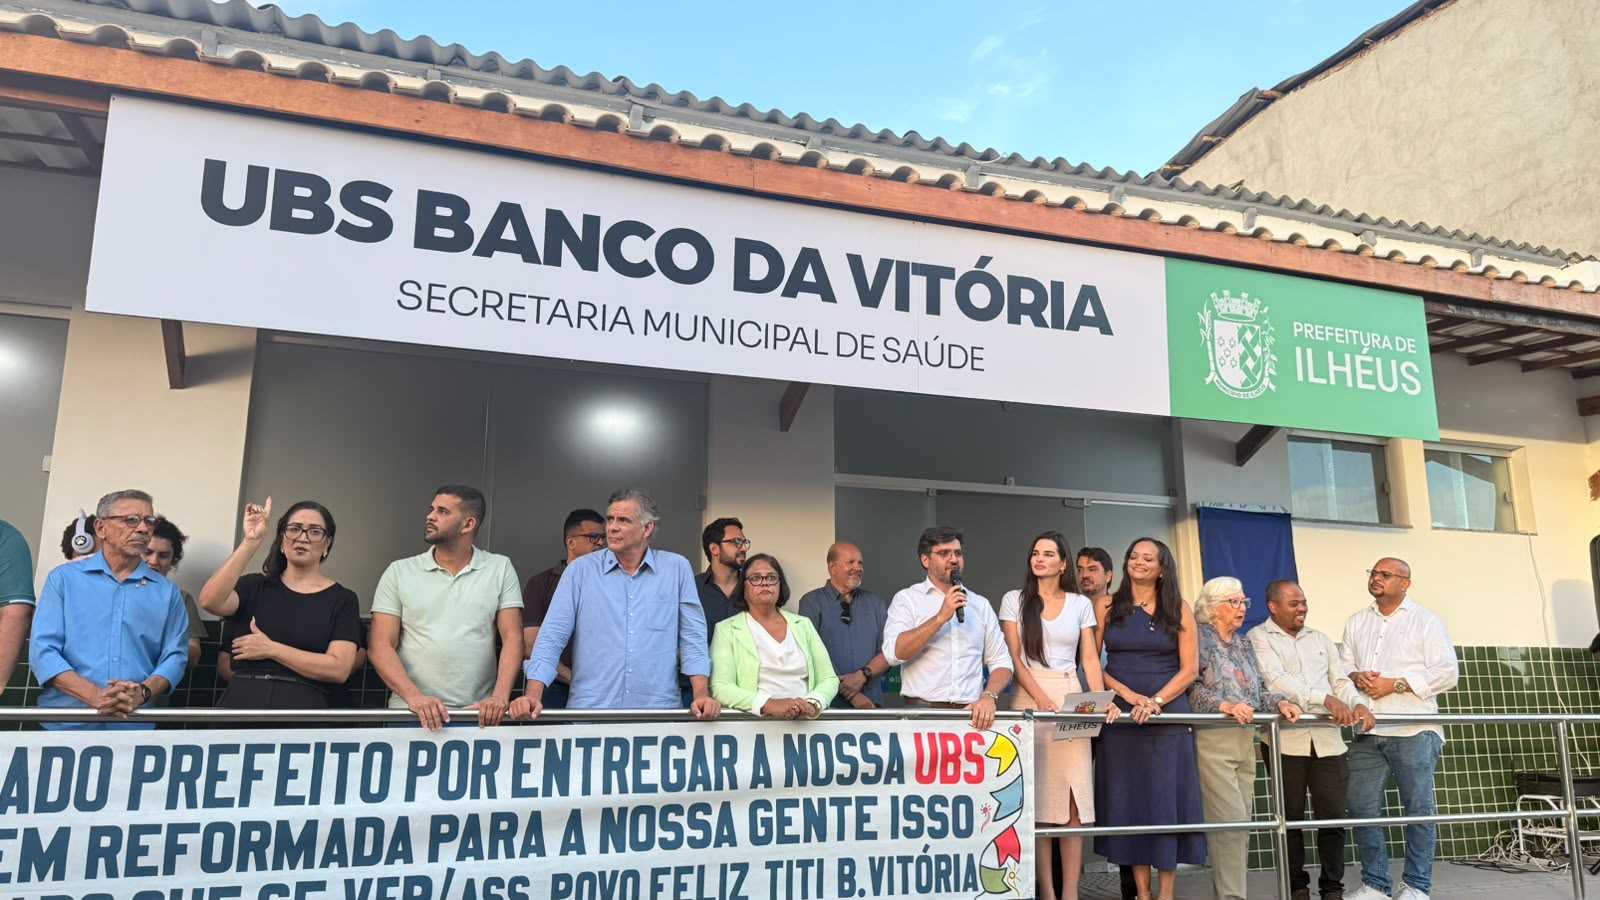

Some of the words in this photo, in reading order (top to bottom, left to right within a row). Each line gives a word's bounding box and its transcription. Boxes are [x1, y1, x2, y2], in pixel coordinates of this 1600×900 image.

[200, 158, 393, 244] UBS
[413, 188, 715, 286] BANCO
[732, 237, 838, 304] DA
[845, 252, 1114, 336] VITÓRIA
[396, 279, 635, 335] SECRETARIA
[643, 308, 829, 356] MUNICIPAL
[836, 331, 876, 361] DE
[882, 335, 985, 372] SAÚDE
[1293, 320, 1393, 351] PREFEITURA
[1394, 335, 1417, 354] DE
[1295, 346, 1422, 396] ILHÉUS
[127, 742, 393, 811] PREFEITO
[404, 740, 501, 802] POR
[511, 734, 739, 798] ENTREGAR
[749, 734, 773, 790] A
[783, 732, 906, 789] NOSSA
[913, 732, 986, 785] UBS
[84, 816, 414, 880] REFORMADA
[427, 811, 547, 863] PARA
[558, 808, 587, 857] A
[599, 801, 738, 855] NOSSA
[748, 796, 878, 847] GENTE
[890, 794, 975, 840] ISSO
[649, 862, 750, 900] FELIZ
[764, 858, 825, 900] TITI
